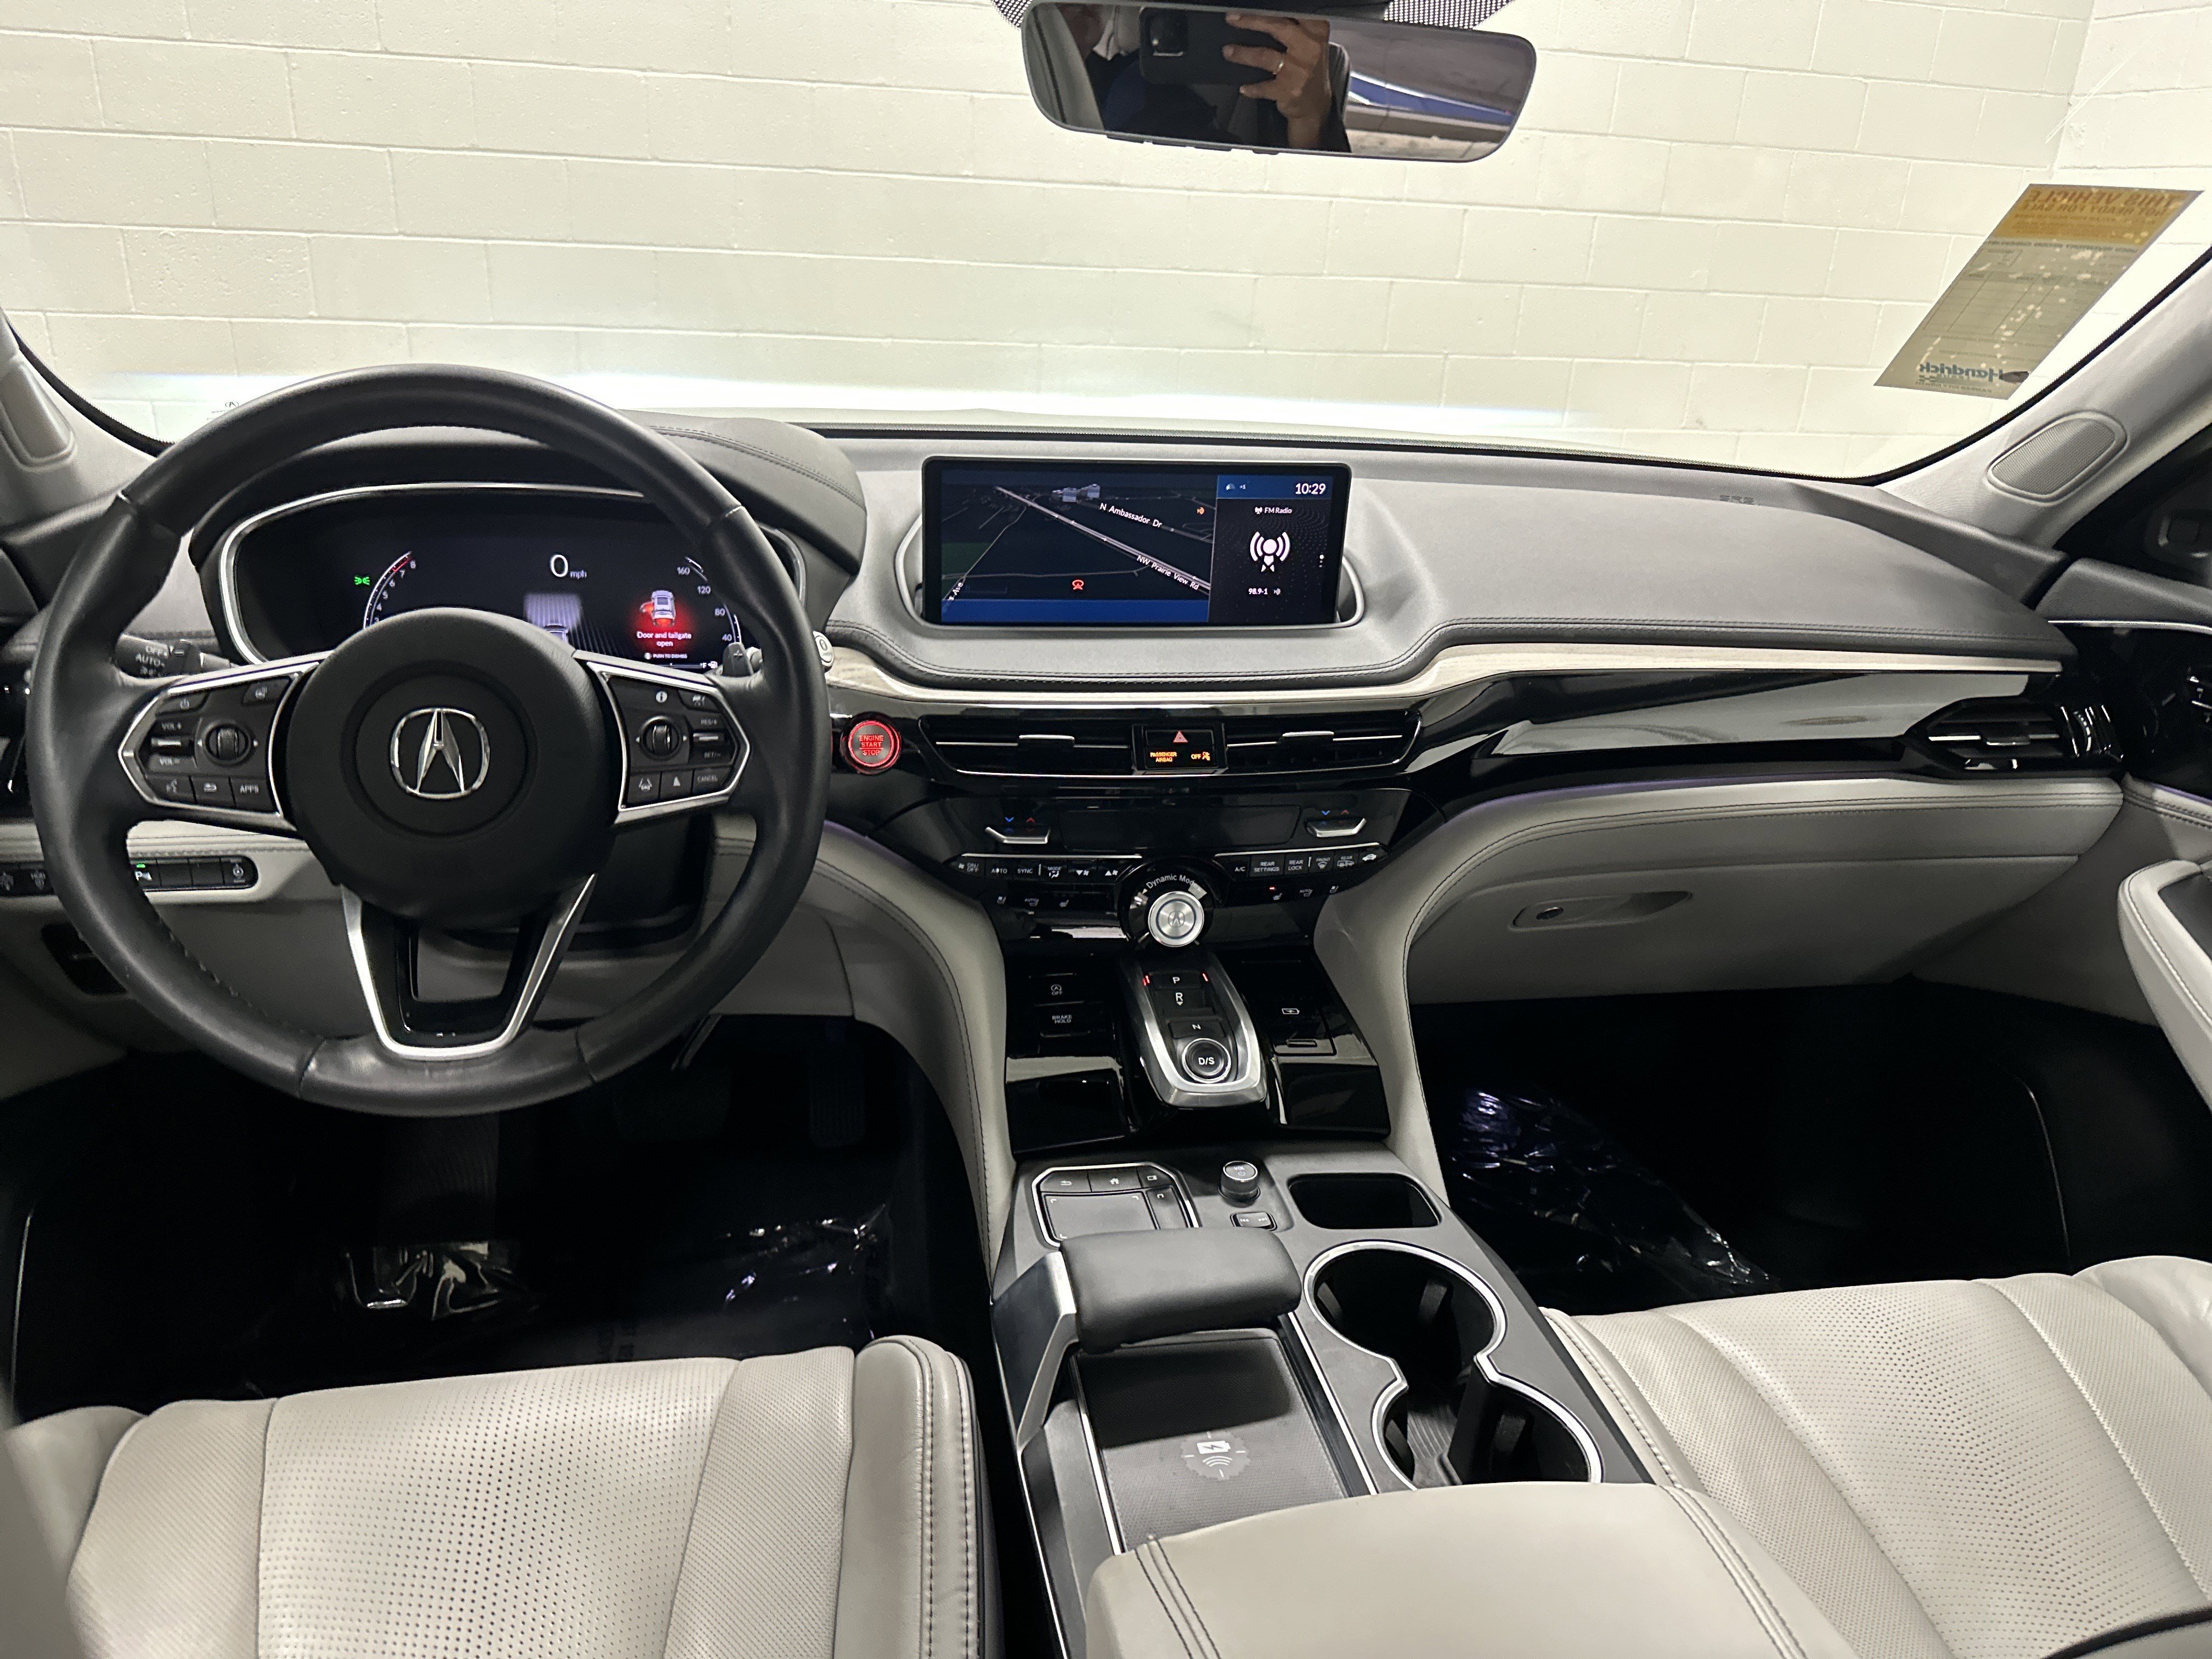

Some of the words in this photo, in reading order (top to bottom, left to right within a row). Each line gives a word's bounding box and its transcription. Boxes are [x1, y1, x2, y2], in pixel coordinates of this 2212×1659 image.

[1295, 483, 1326, 494] 10:29
[1100, 503, 1107, 511] N
[1109, 505, 1150, 524] Ambassador
[1152, 519, 1163, 528] Dr
[570, 570, 587, 580] mph
[677, 567, 690, 575] 160
[1137, 555, 1150, 566] NW
[1151, 562, 1171, 577] Prairie
[1173, 572, 1189, 585] View
[1189, 582, 1200, 591] Rd
[697, 586, 711, 595] 120
[715, 608, 726, 617] 80
[668, 632, 692, 640] tailgate
[1146, 873, 1178, 889] Dynamic
[1175, 992, 1183, 1002] R
[1198, 1057, 1215, 1065] D/S
